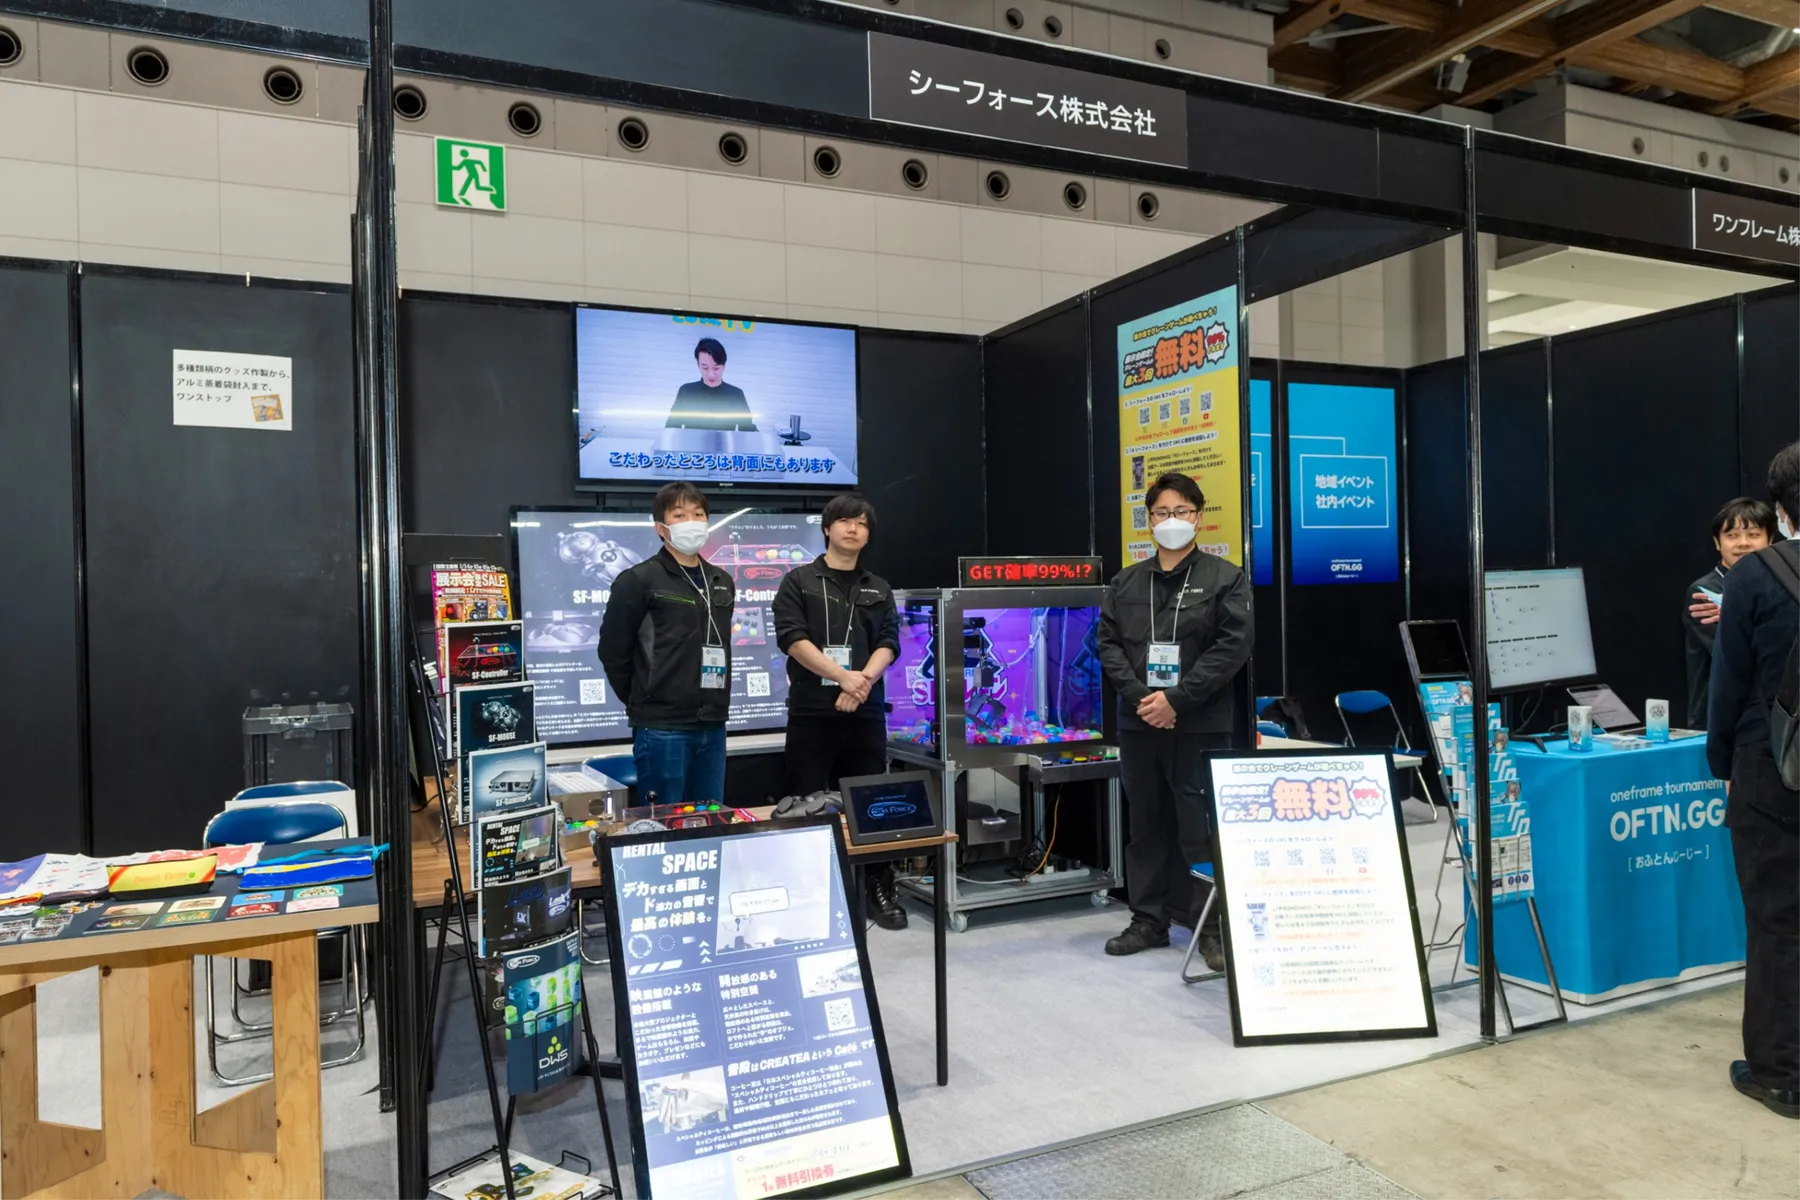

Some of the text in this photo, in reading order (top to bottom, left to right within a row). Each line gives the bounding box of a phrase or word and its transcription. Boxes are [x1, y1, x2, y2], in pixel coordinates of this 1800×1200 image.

[908, 69, 1157, 137] シーフォース株式会社
[1713, 213, 1800, 247] ワンフレーム株
[1154, 326, 1206, 379] 無料
[177, 392, 232, 402] ワンストップ
[609, 451, 836, 472] こだわったところは背面にもあります
[1315, 474, 1374, 489] 地域イベント
[1315, 495, 1375, 509] 社内イベント
[572, 590, 611, 604] SF-MO
[735, 588, 779, 602] F-Contr
[1272, 777, 1353, 821] 無料
[1610, 785, 1663, 803] oneframe
[1610, 798, 1726, 842] OFTN.GG
[623, 842, 666, 859] RENTAL
[662, 850, 718, 875] SPACE
[623, 877, 707, 898] デカすぎる画面と
[719, 969, 777, 988] 開放感のある
[630, 982, 702, 1001] 映画館のような
[539, 1048, 569, 1069] DWS
[760, 1052, 811, 1070] CREATEA
[811, 1049, 833, 1060] という
